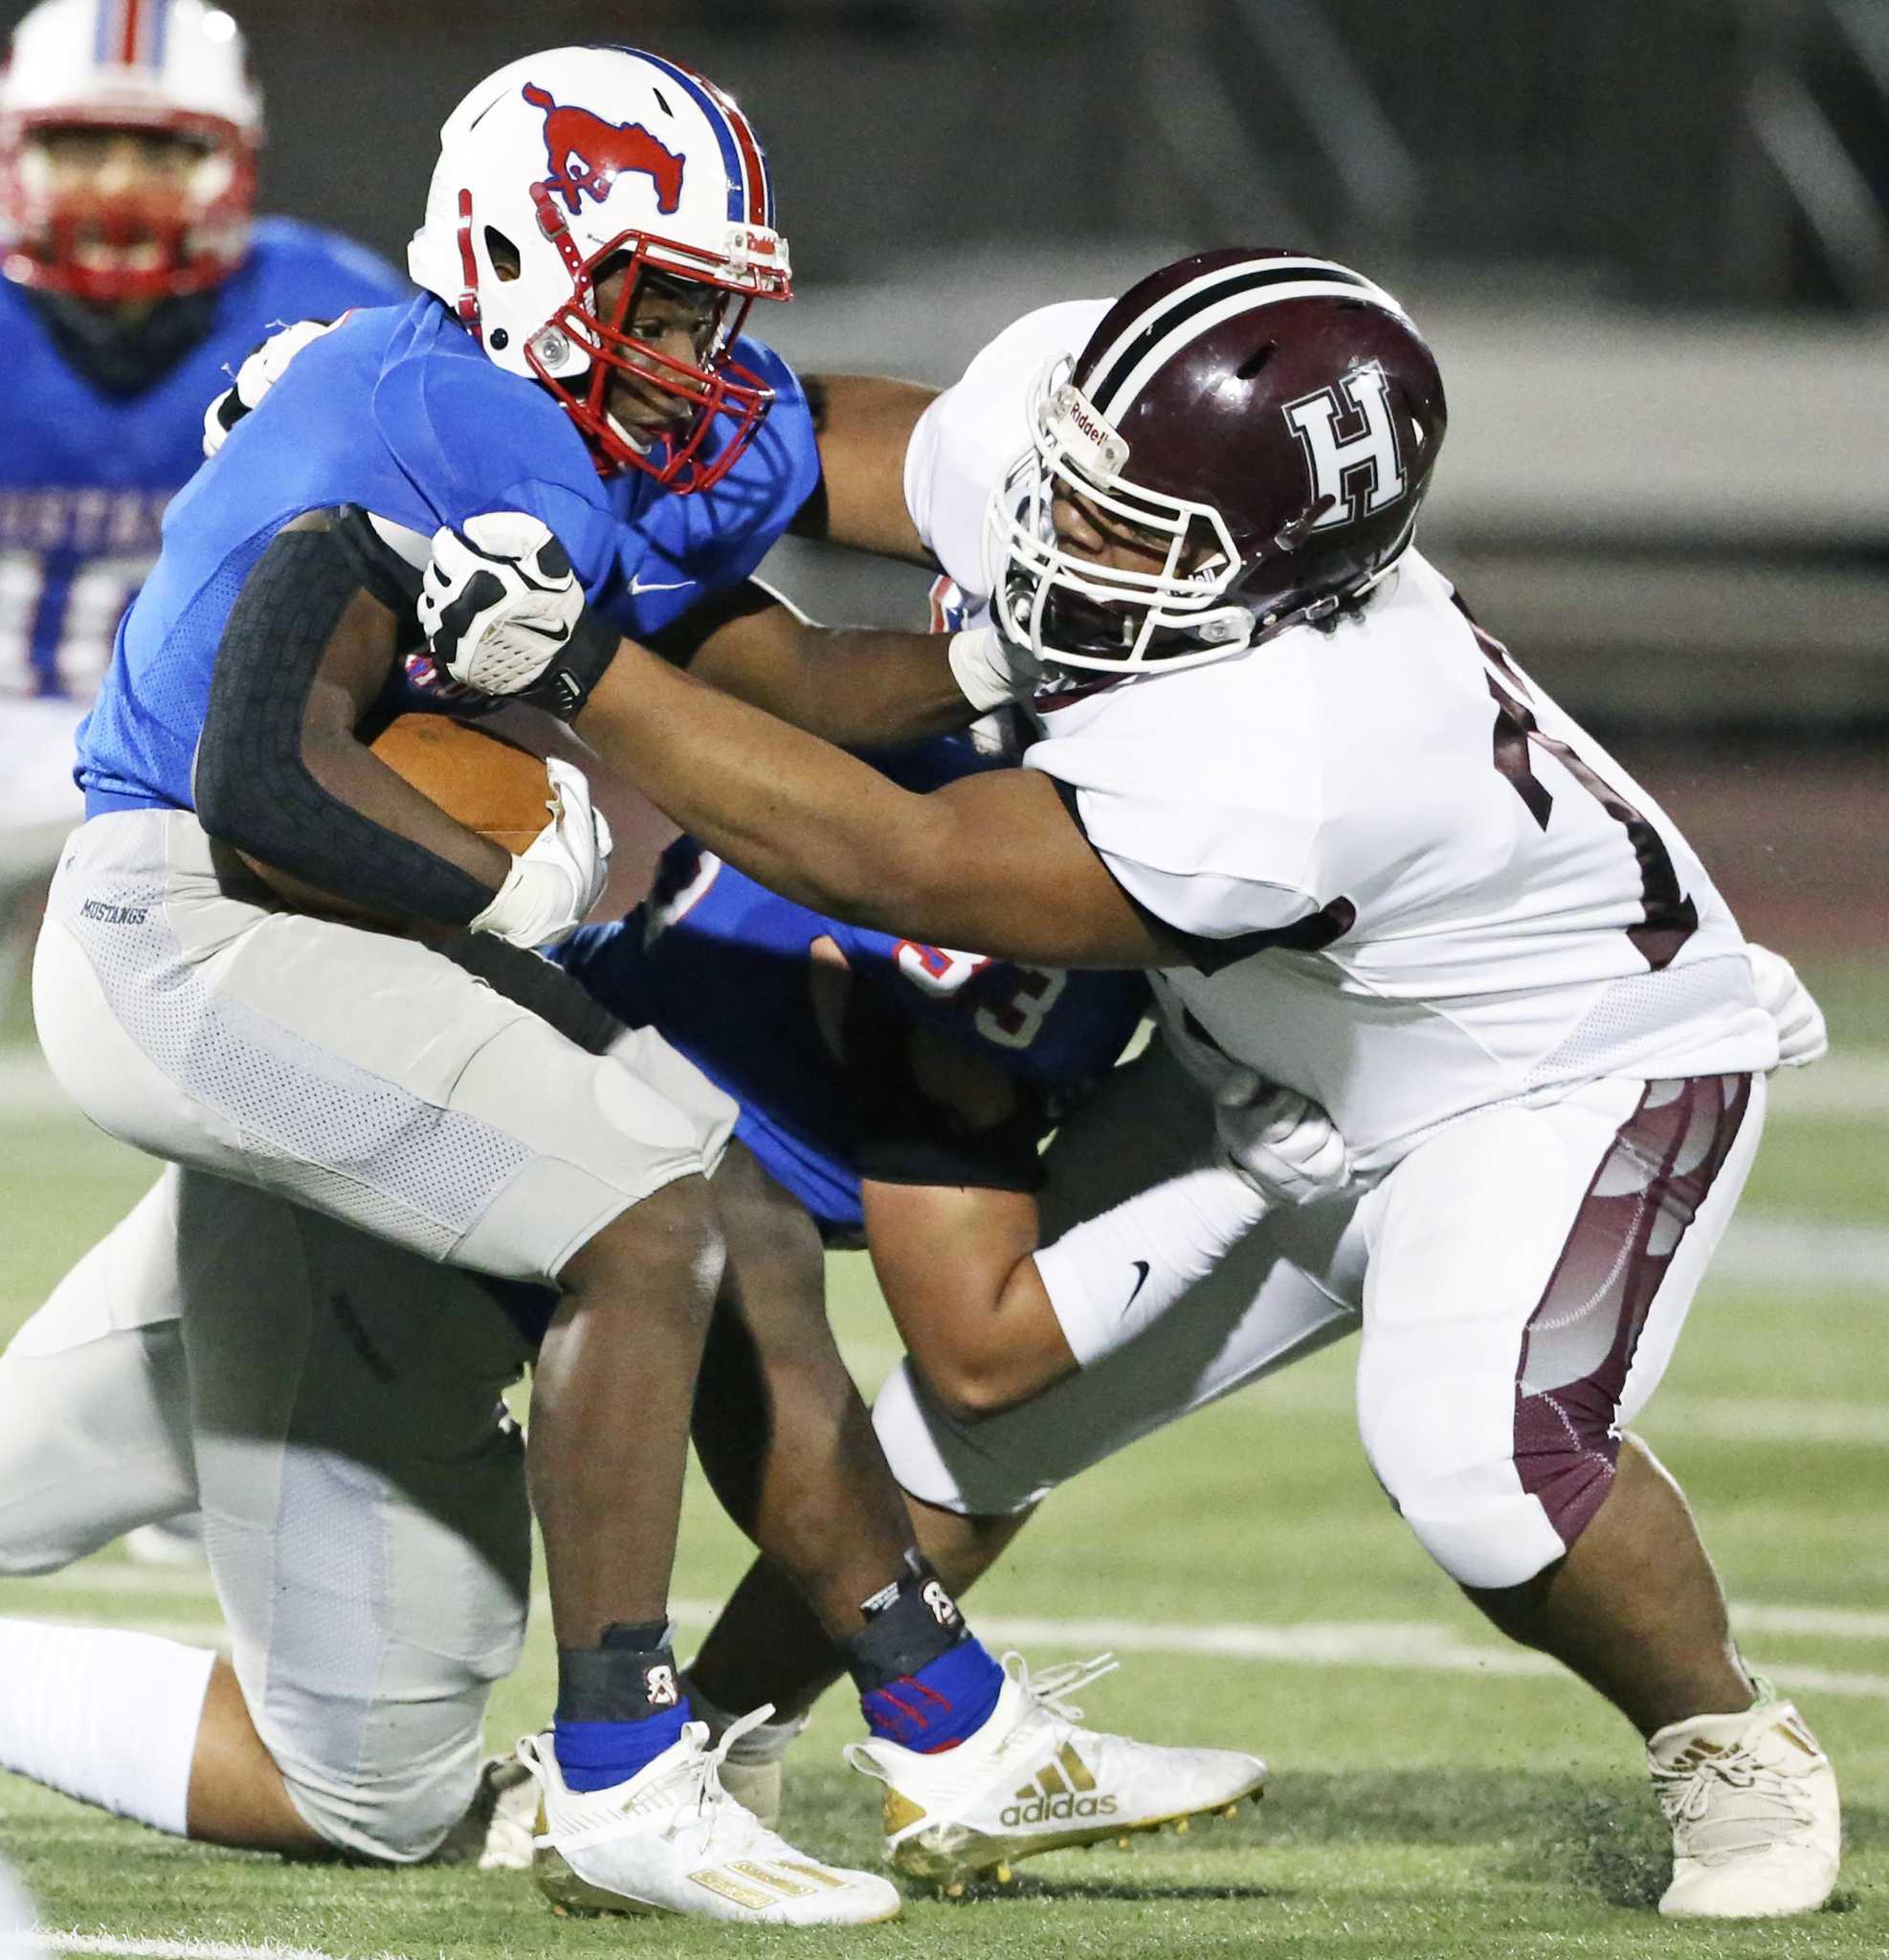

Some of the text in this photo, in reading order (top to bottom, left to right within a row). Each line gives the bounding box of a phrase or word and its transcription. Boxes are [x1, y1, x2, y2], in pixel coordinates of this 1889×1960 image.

[1281, 359, 1408, 533] H
[79, 898, 148, 925] MUSTANGS
[999, 1792, 1119, 1827] adidas
